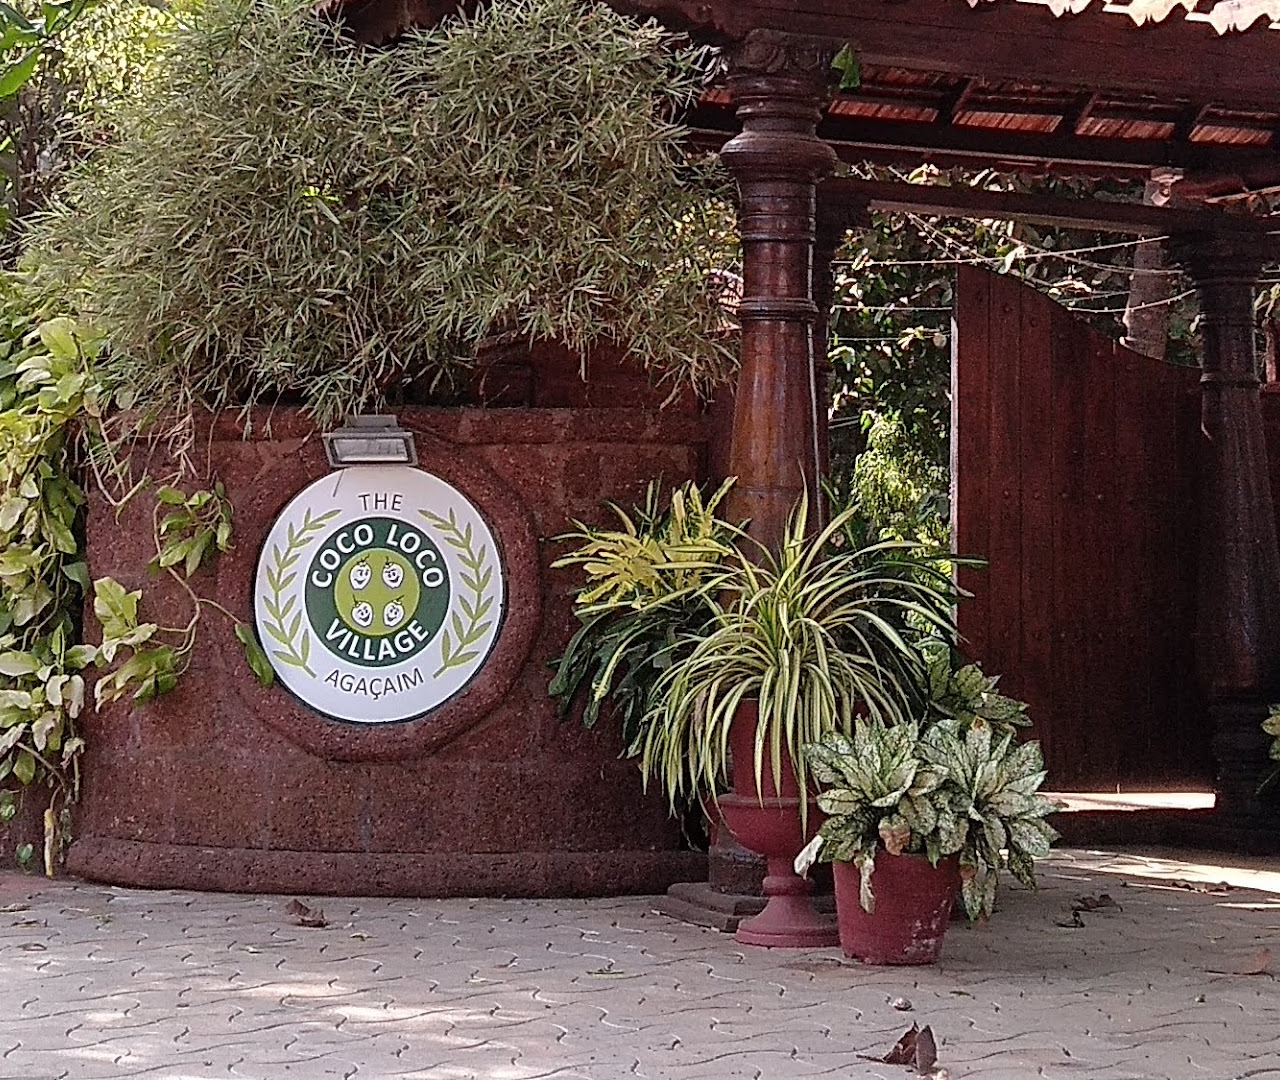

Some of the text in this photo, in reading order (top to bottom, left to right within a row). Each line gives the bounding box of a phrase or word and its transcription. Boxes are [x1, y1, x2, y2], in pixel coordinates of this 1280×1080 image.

[358, 493, 403, 511] THE
[312, 524, 444, 588] COCO LOCO
[325, 618, 429, 660] VILLAGE
[324, 668, 424, 700] AGAÇAIM
